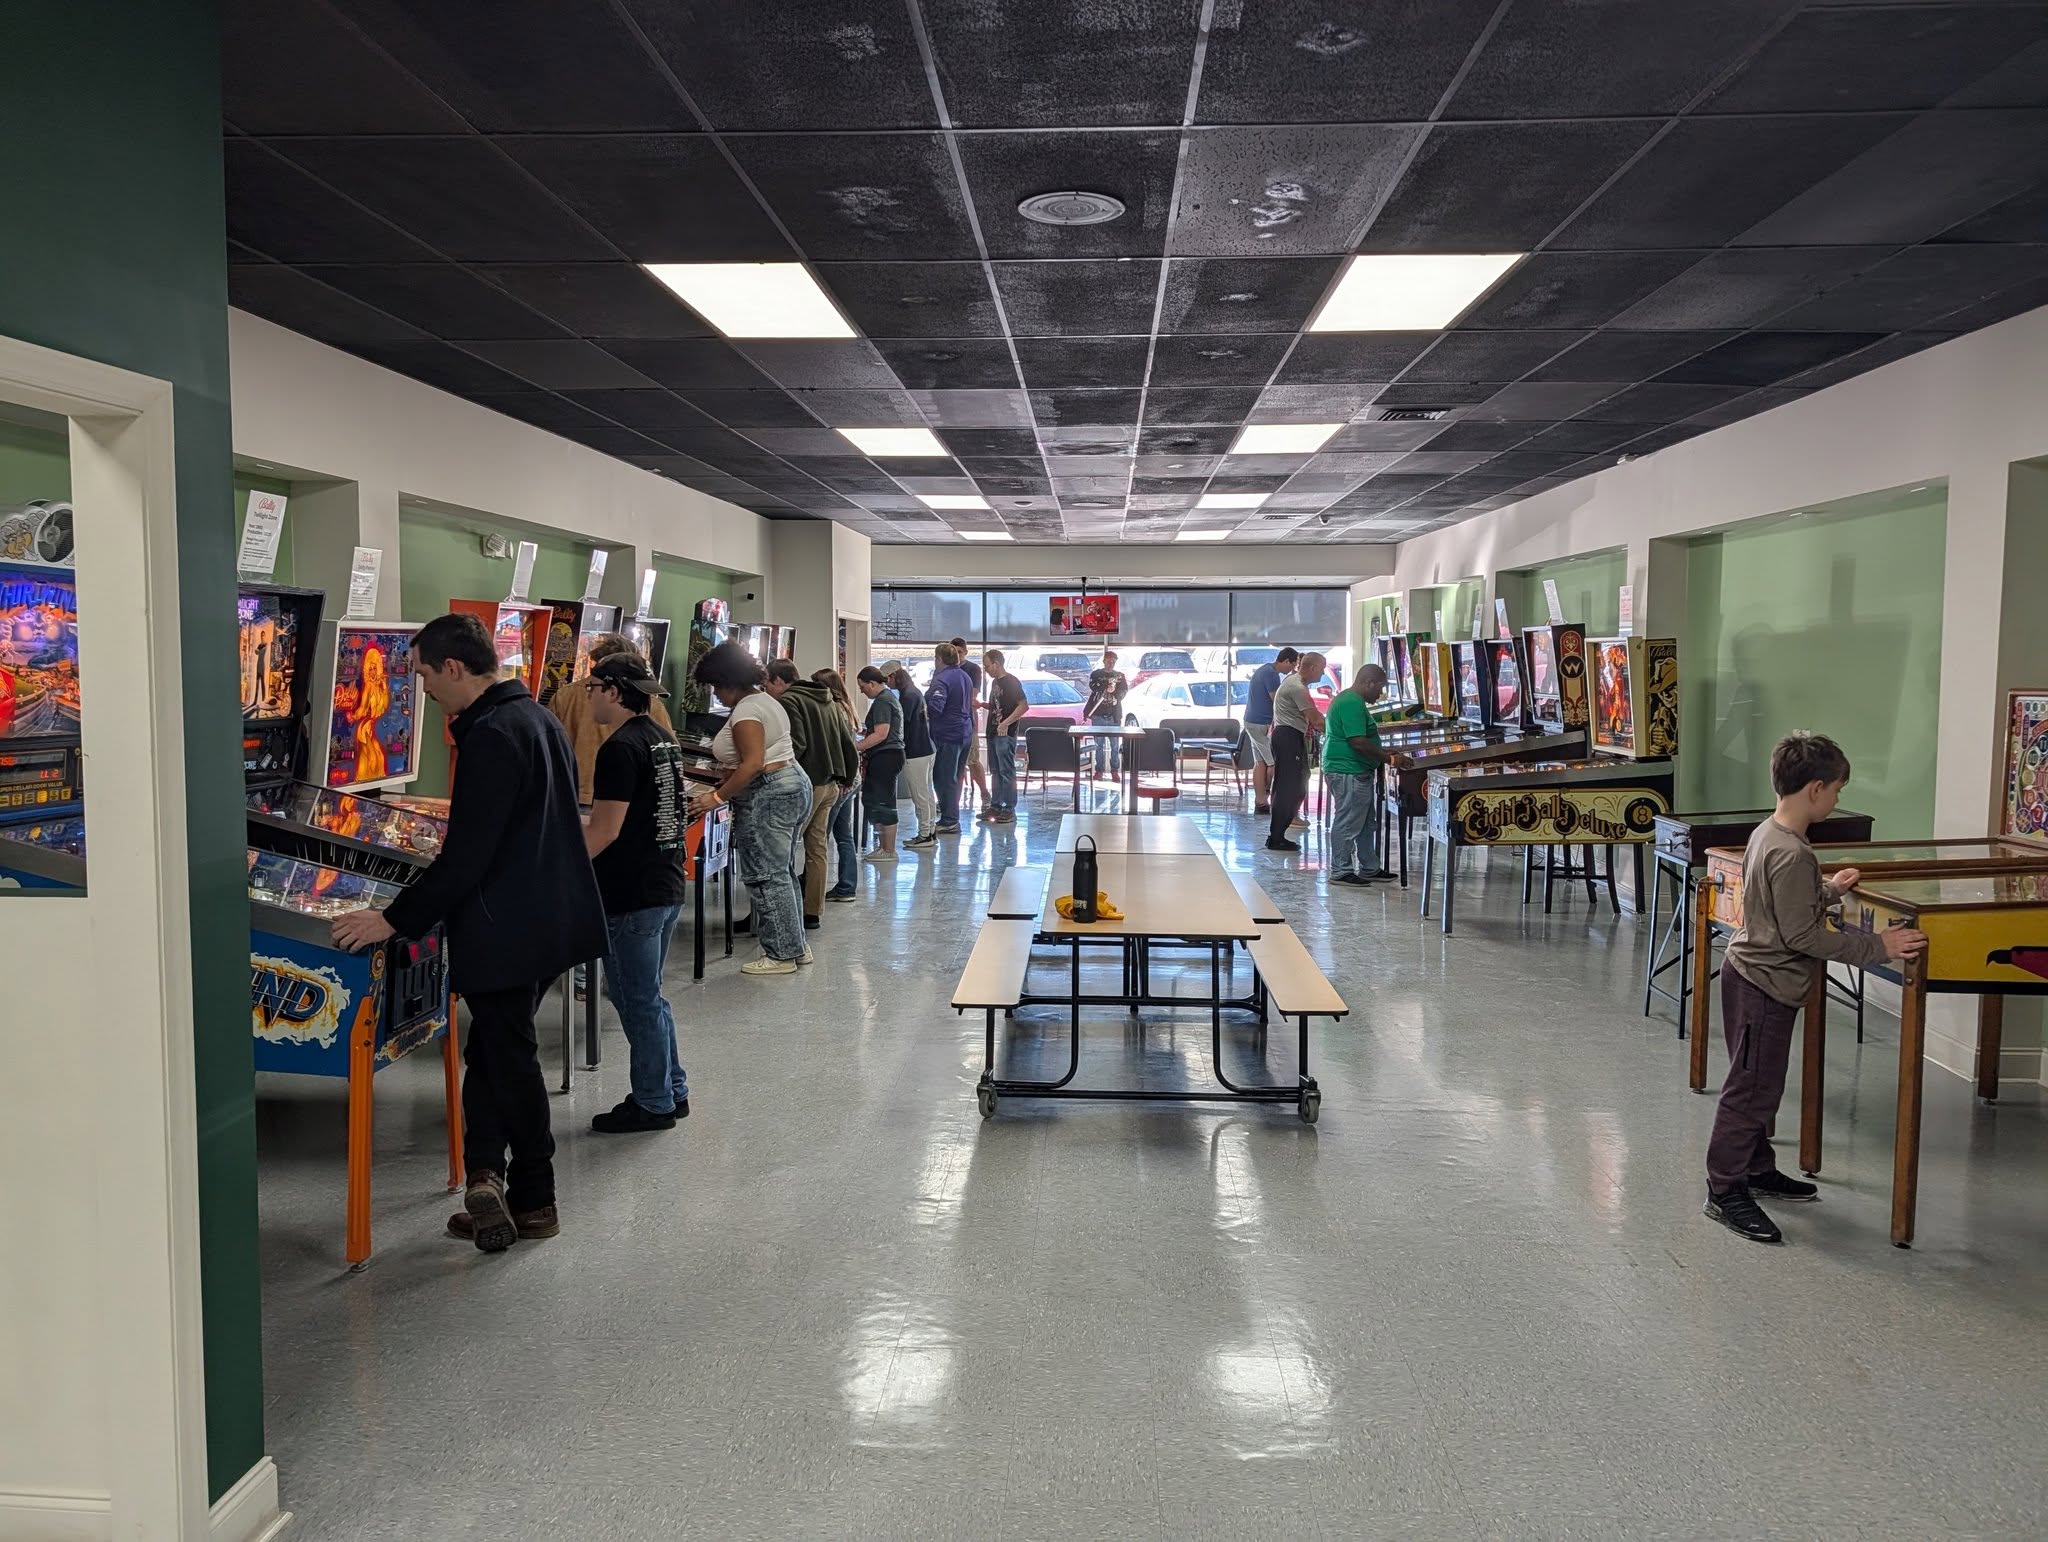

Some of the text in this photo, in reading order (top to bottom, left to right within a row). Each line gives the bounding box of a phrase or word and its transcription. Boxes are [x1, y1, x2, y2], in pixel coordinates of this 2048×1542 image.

[258, 497, 276, 513] Bally
[1563, 661, 1582, 676] W
[1464, 795, 1520, 839] Eight
[1514, 793, 1562, 832] Ball
[1553, 796, 1629, 839] Deluxe
